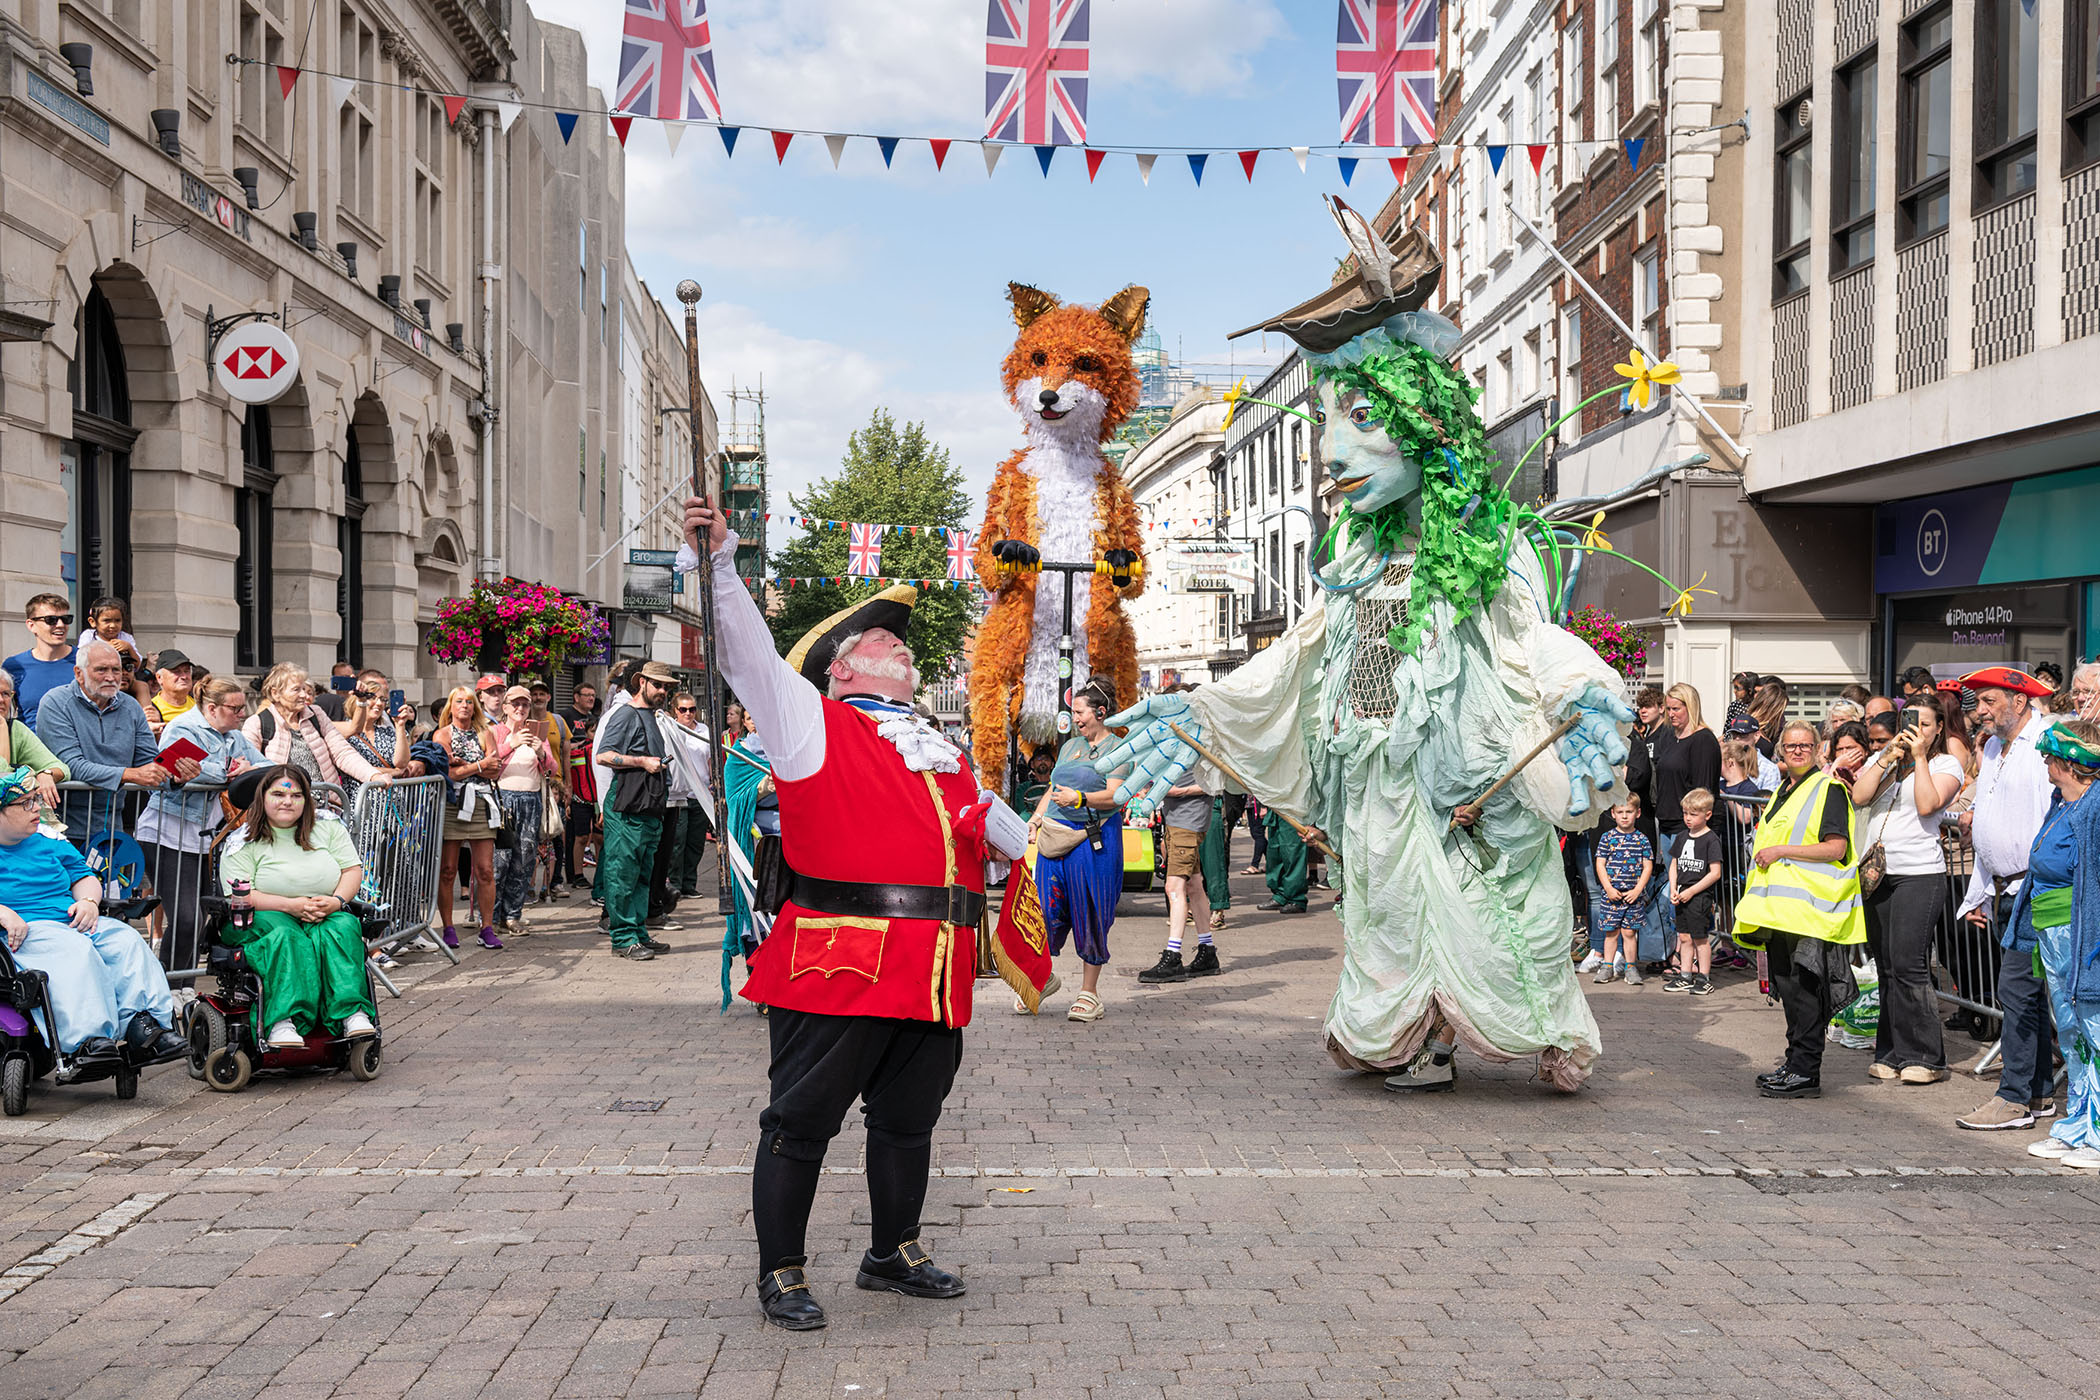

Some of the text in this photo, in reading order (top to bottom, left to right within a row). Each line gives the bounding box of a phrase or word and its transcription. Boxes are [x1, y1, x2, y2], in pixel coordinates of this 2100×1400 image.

[31, 77, 109, 139] NORTHGATE STREET
[181, 172, 253, 242] HSBC UK
[1187, 545, 1234, 554] NEW INN
[1924, 530, 1941, 555] BT
[1192, 579, 1230, 588] HOTEL
[623, 596, 645, 606] 01242
[1953, 606, 2013, 625] iPhone 14 Pro
